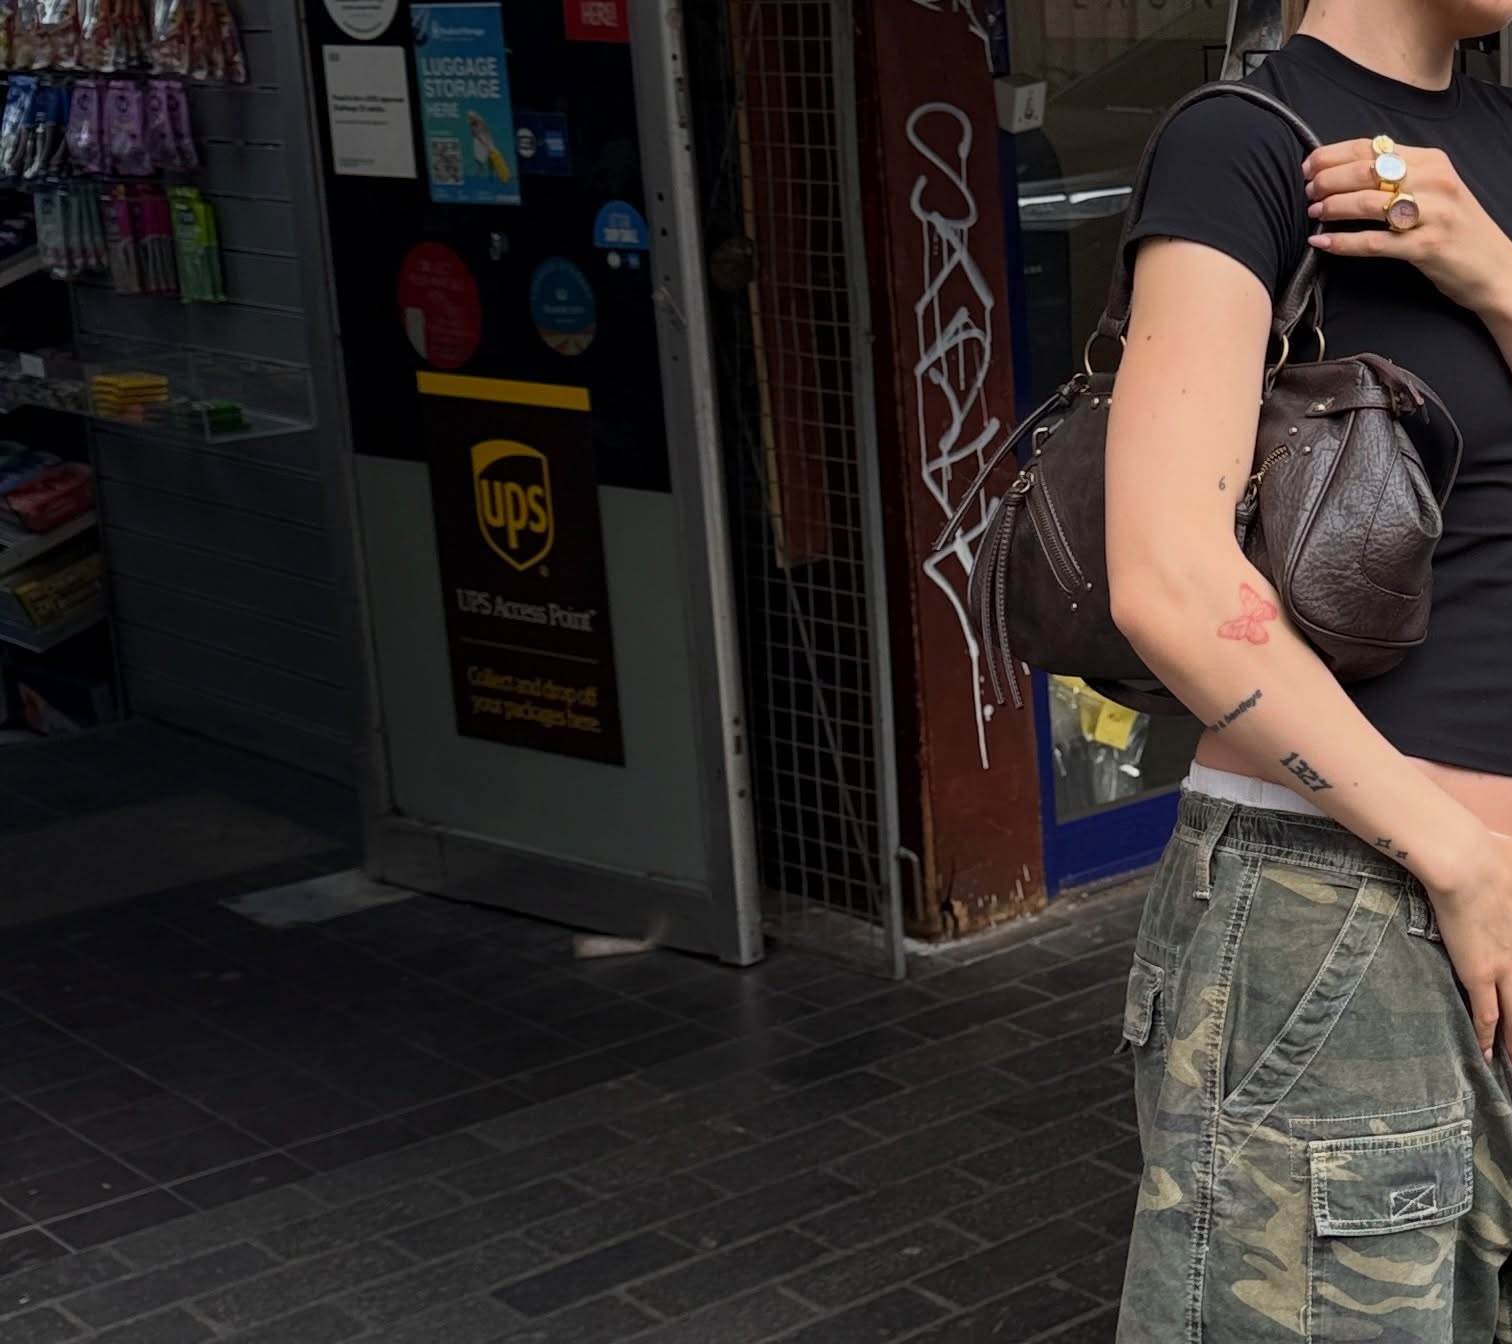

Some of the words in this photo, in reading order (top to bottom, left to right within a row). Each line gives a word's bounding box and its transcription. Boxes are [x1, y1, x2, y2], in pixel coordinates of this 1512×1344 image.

[421, 56, 501, 78] LUGGAGE
[423, 78, 503, 100] STORAGE
[456, 587, 495, 616] UPS
[494, 595, 548, 625] Access
[1279, 752, 1333, 793] 1327
